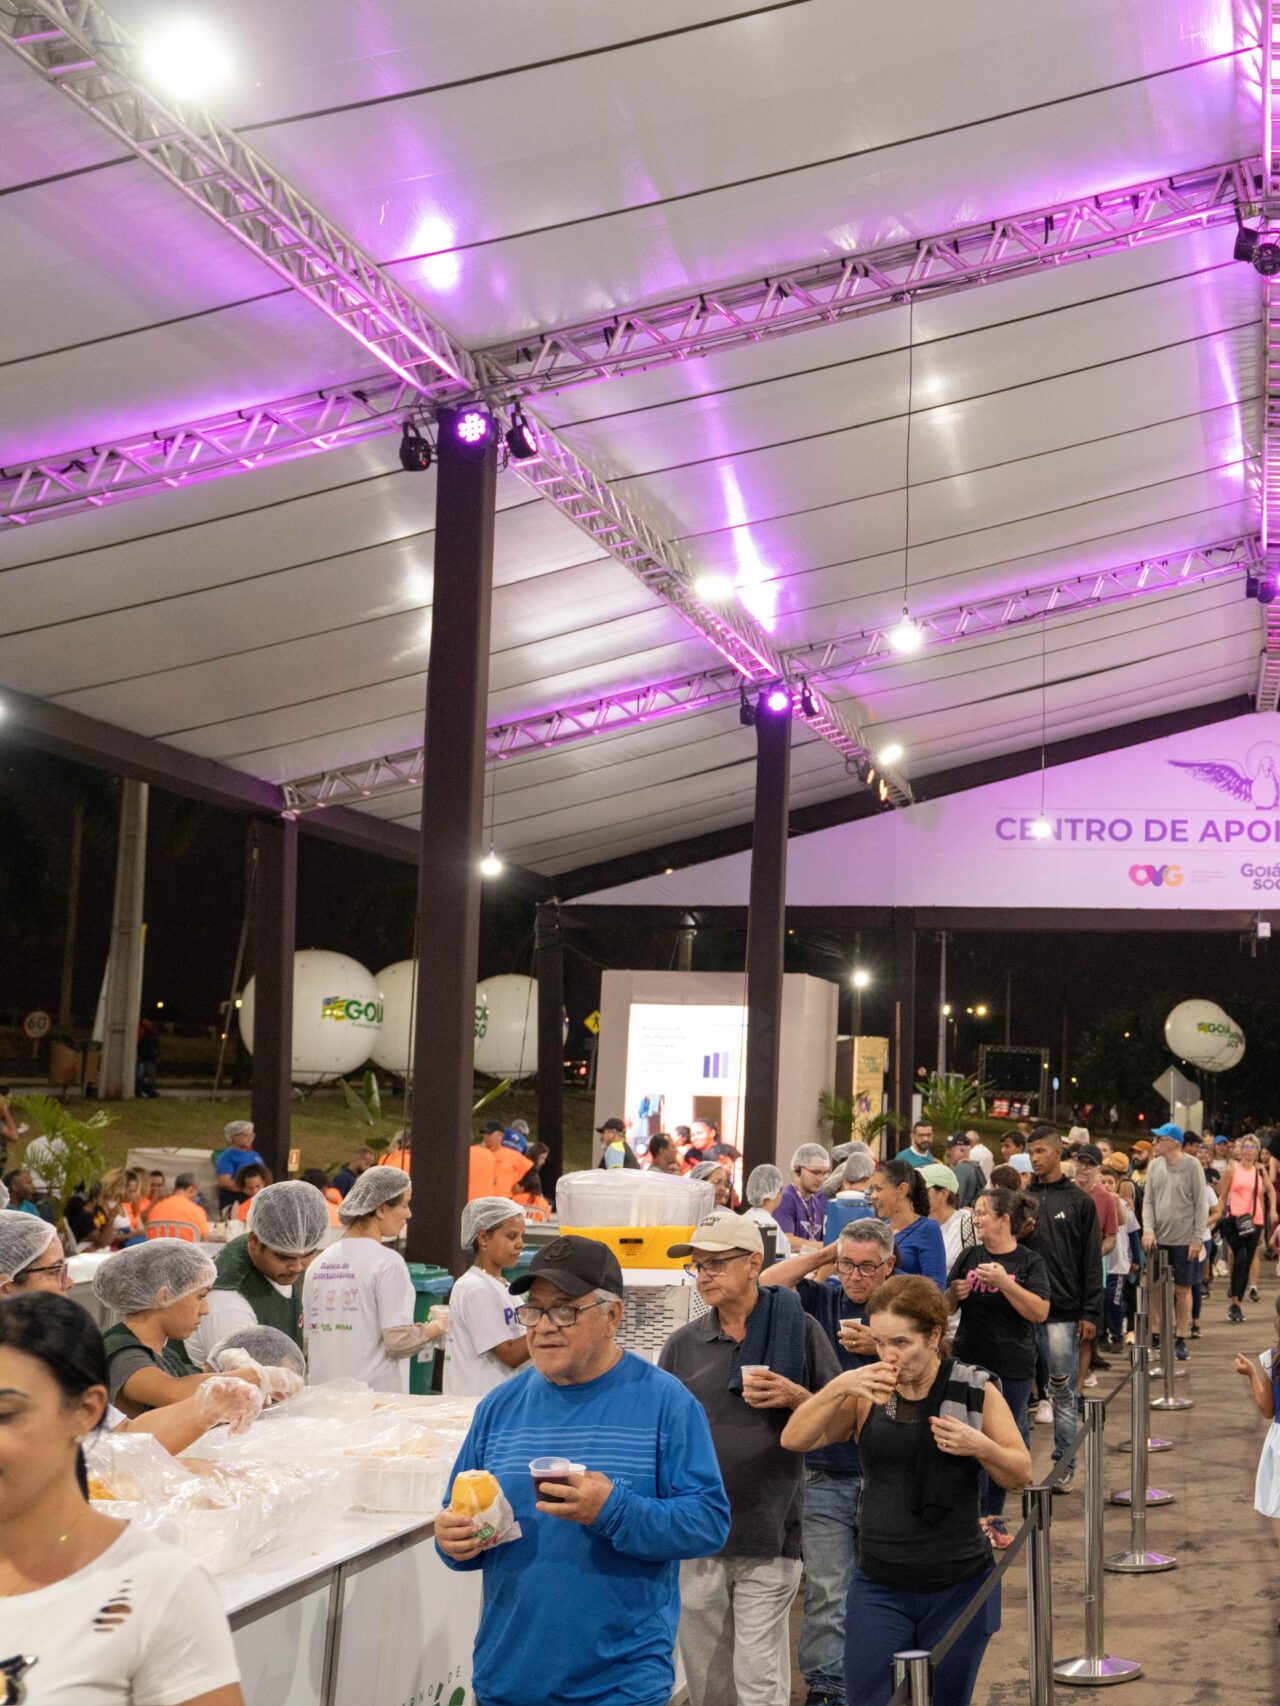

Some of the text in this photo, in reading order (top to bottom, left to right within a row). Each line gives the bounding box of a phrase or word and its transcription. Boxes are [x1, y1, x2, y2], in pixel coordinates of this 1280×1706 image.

[1144, 819, 1188, 842] DE
[1128, 864, 1184, 887] OVG
[28, 1016, 47, 1029] 60
